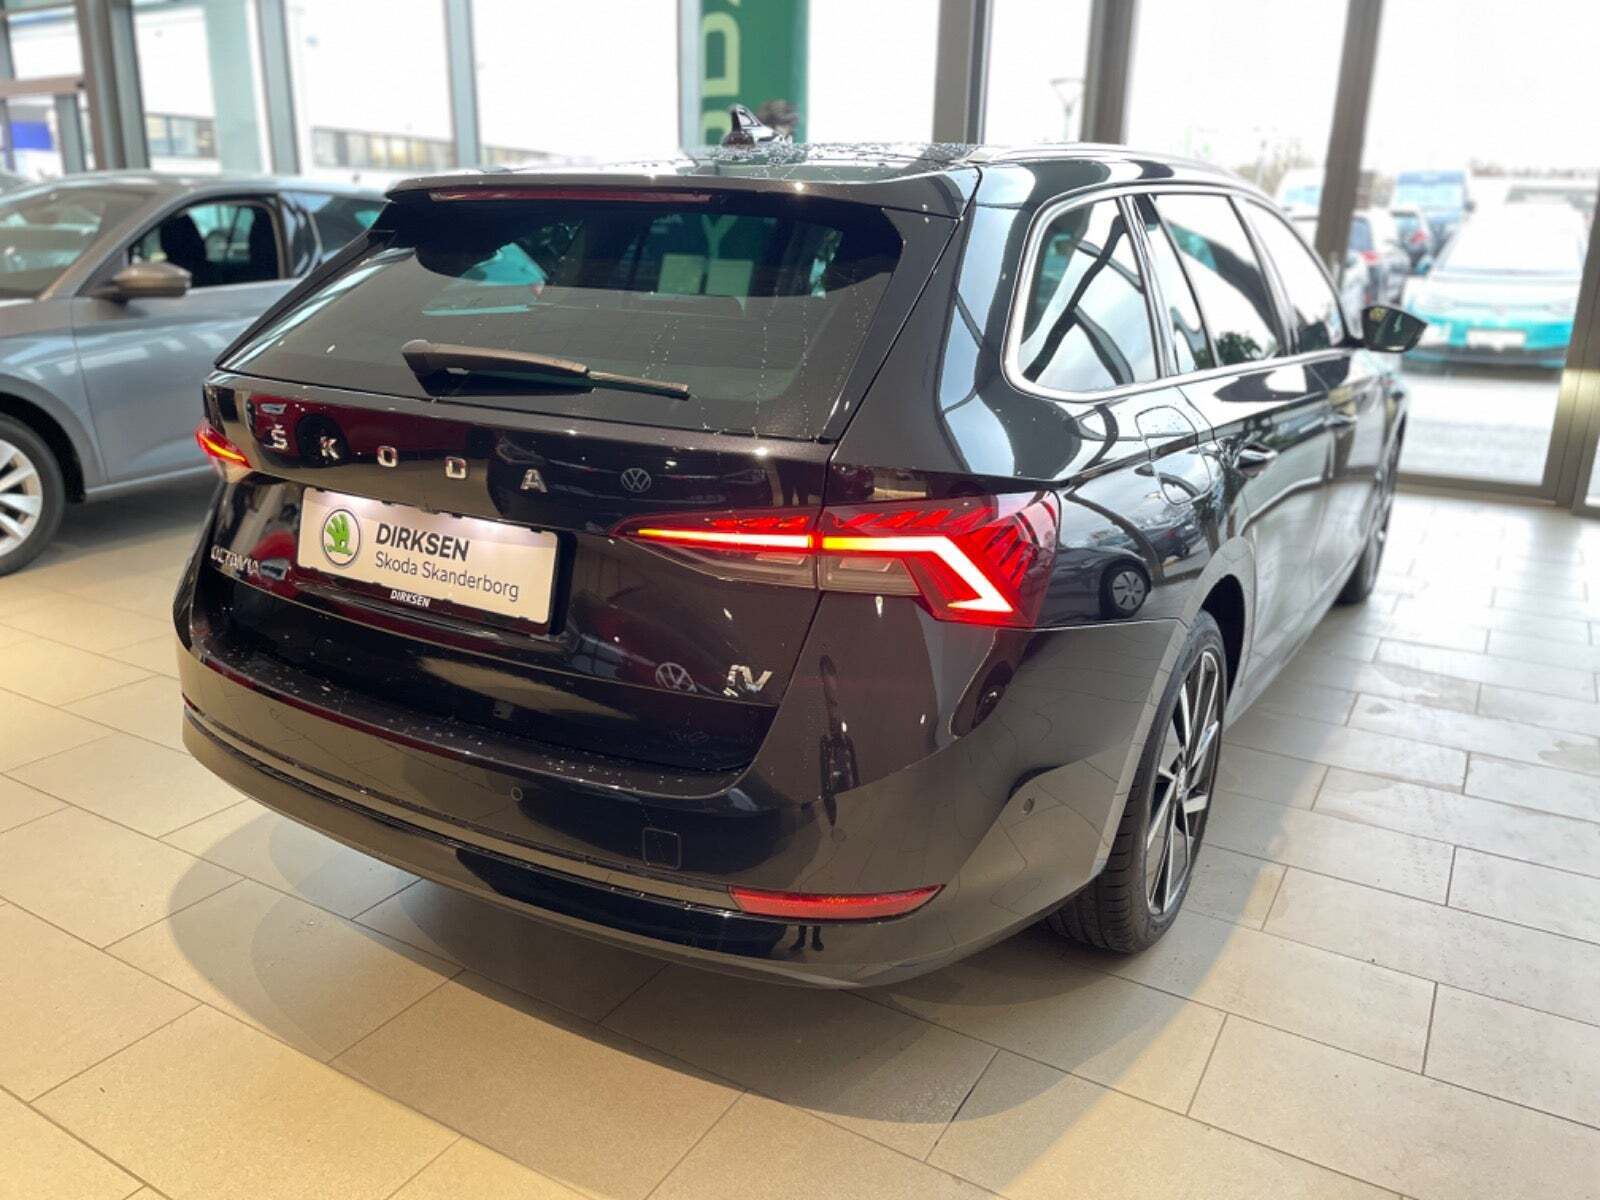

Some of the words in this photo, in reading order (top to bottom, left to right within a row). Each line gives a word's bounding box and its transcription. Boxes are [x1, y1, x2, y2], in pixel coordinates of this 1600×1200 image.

[269, 424, 548, 493] ŠKODA
[376, 523, 470, 562] DIRKSEN
[376, 550, 418, 576] Skoda
[422, 561, 519, 601] Skanderborg
[390, 589, 431, 608] DIRKSEN
